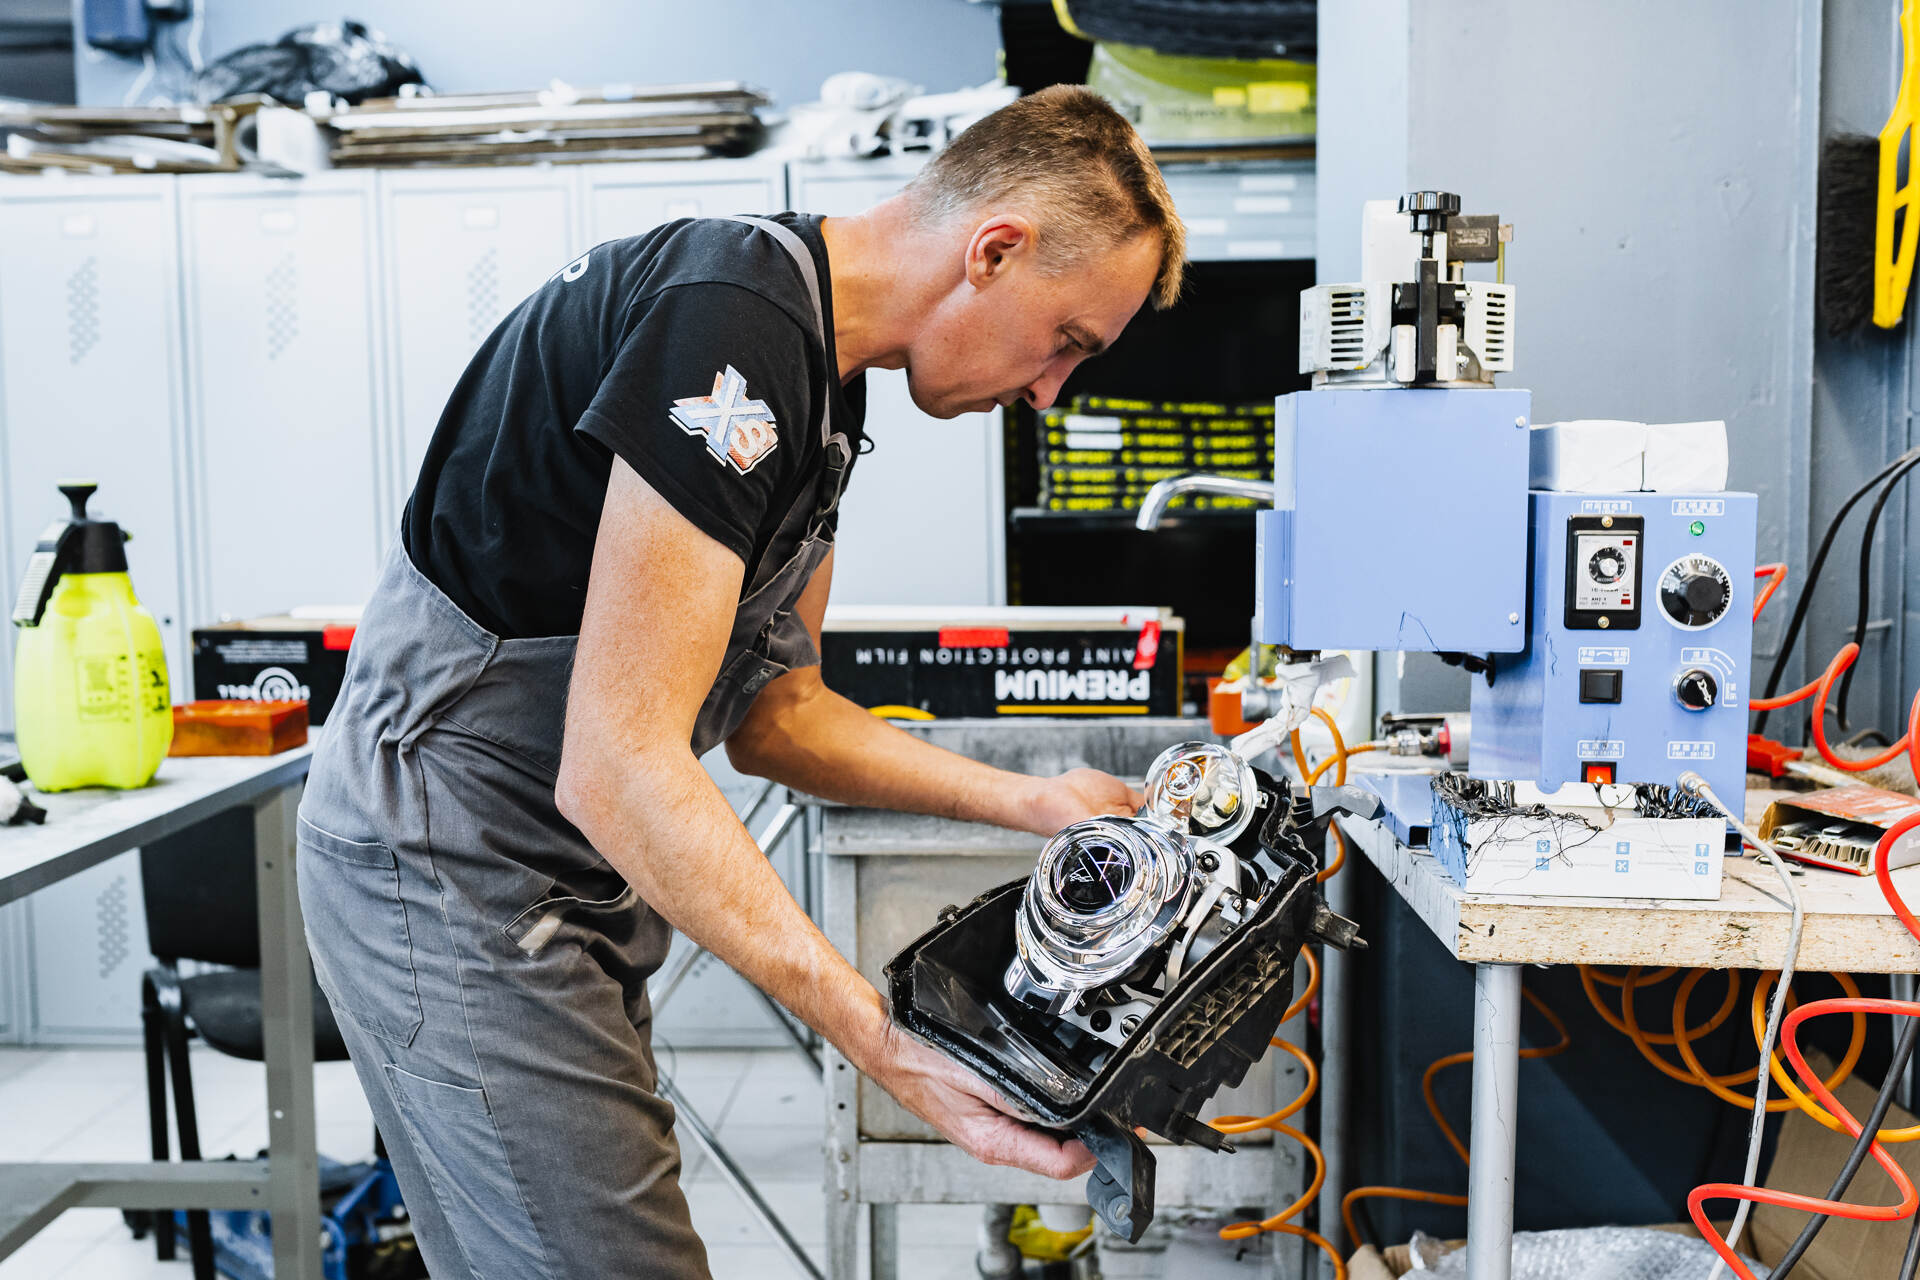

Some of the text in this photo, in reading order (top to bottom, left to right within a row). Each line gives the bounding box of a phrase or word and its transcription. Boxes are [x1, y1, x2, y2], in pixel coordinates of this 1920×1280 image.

[855, 647, 1138, 665] AINT PROTECTION FILM
[995, 669, 1150, 701] PREMIUM
